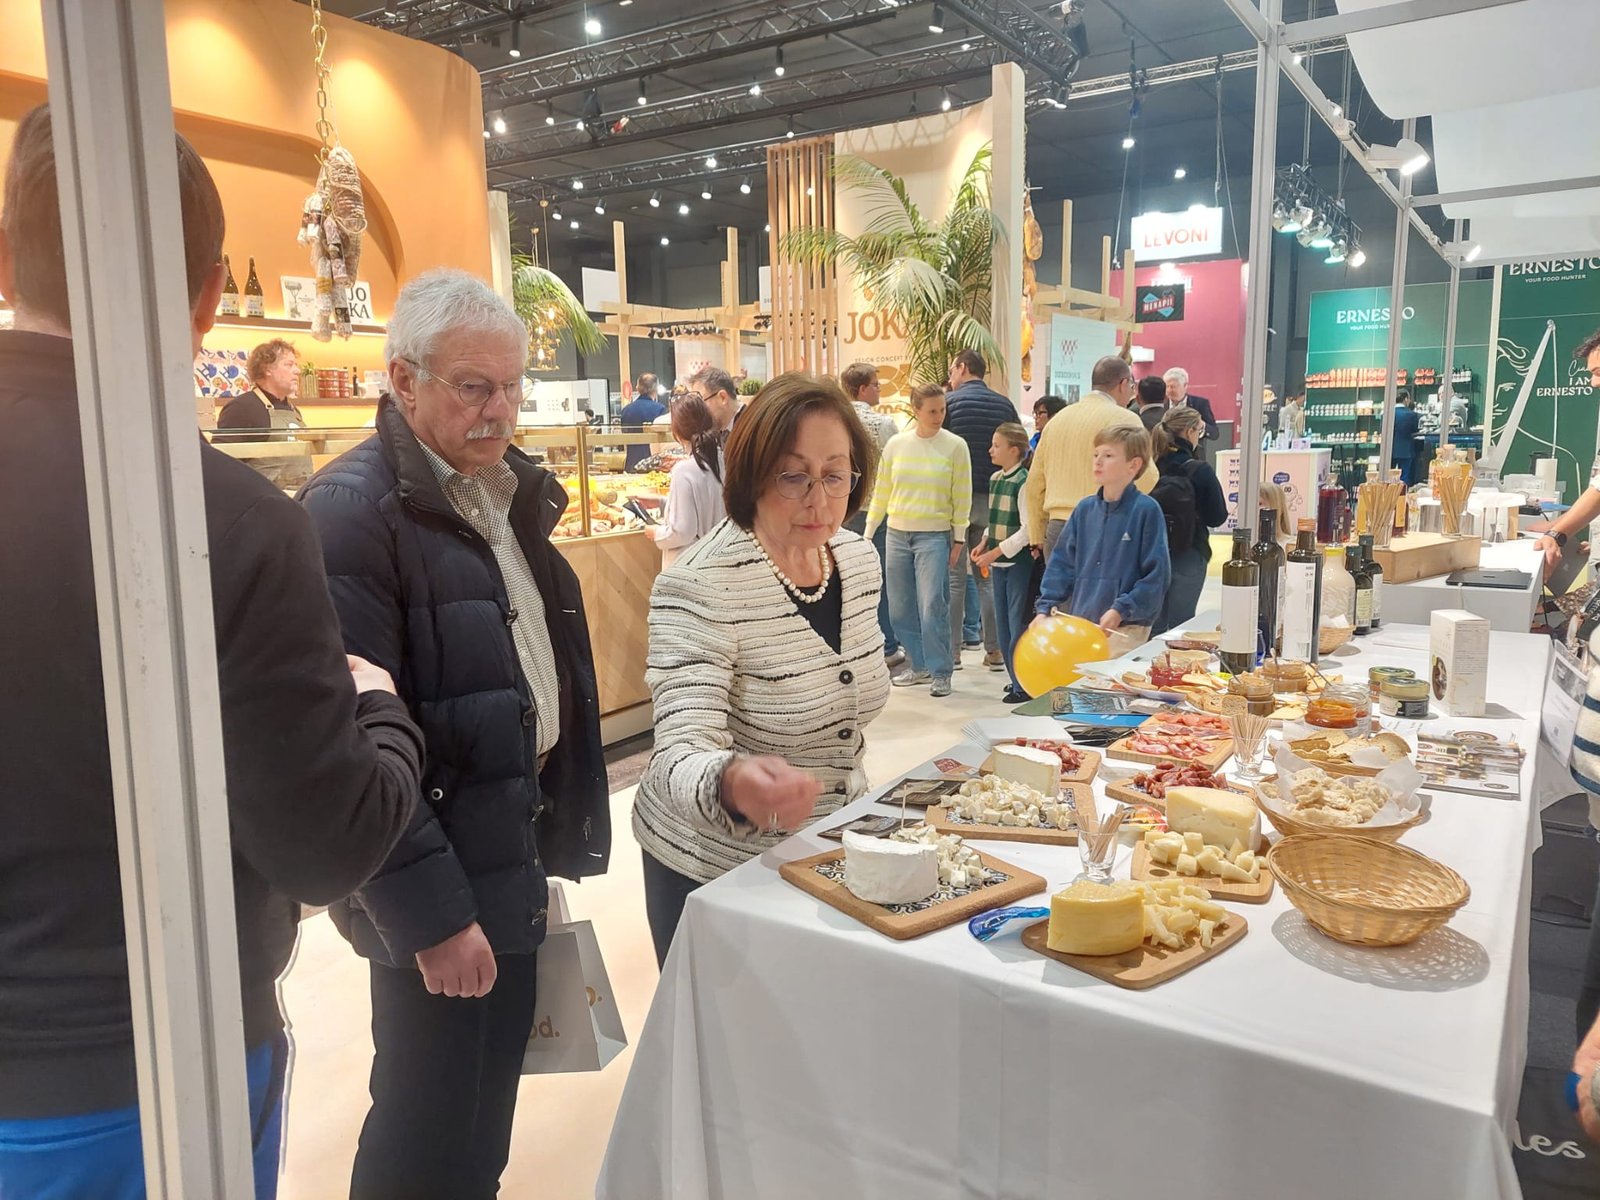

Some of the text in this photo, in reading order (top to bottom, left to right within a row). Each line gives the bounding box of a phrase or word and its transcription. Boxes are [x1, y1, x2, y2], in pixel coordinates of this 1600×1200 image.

[1144, 226, 1208, 248] LEVONI
[1509, 257, 1600, 276] ERNESTO
[350, 302, 371, 319] KA
[1336, 306, 1415, 324] ERNESO
[843, 307, 909, 345] JOK
[1536, 386, 1593, 397] ERNESTO
